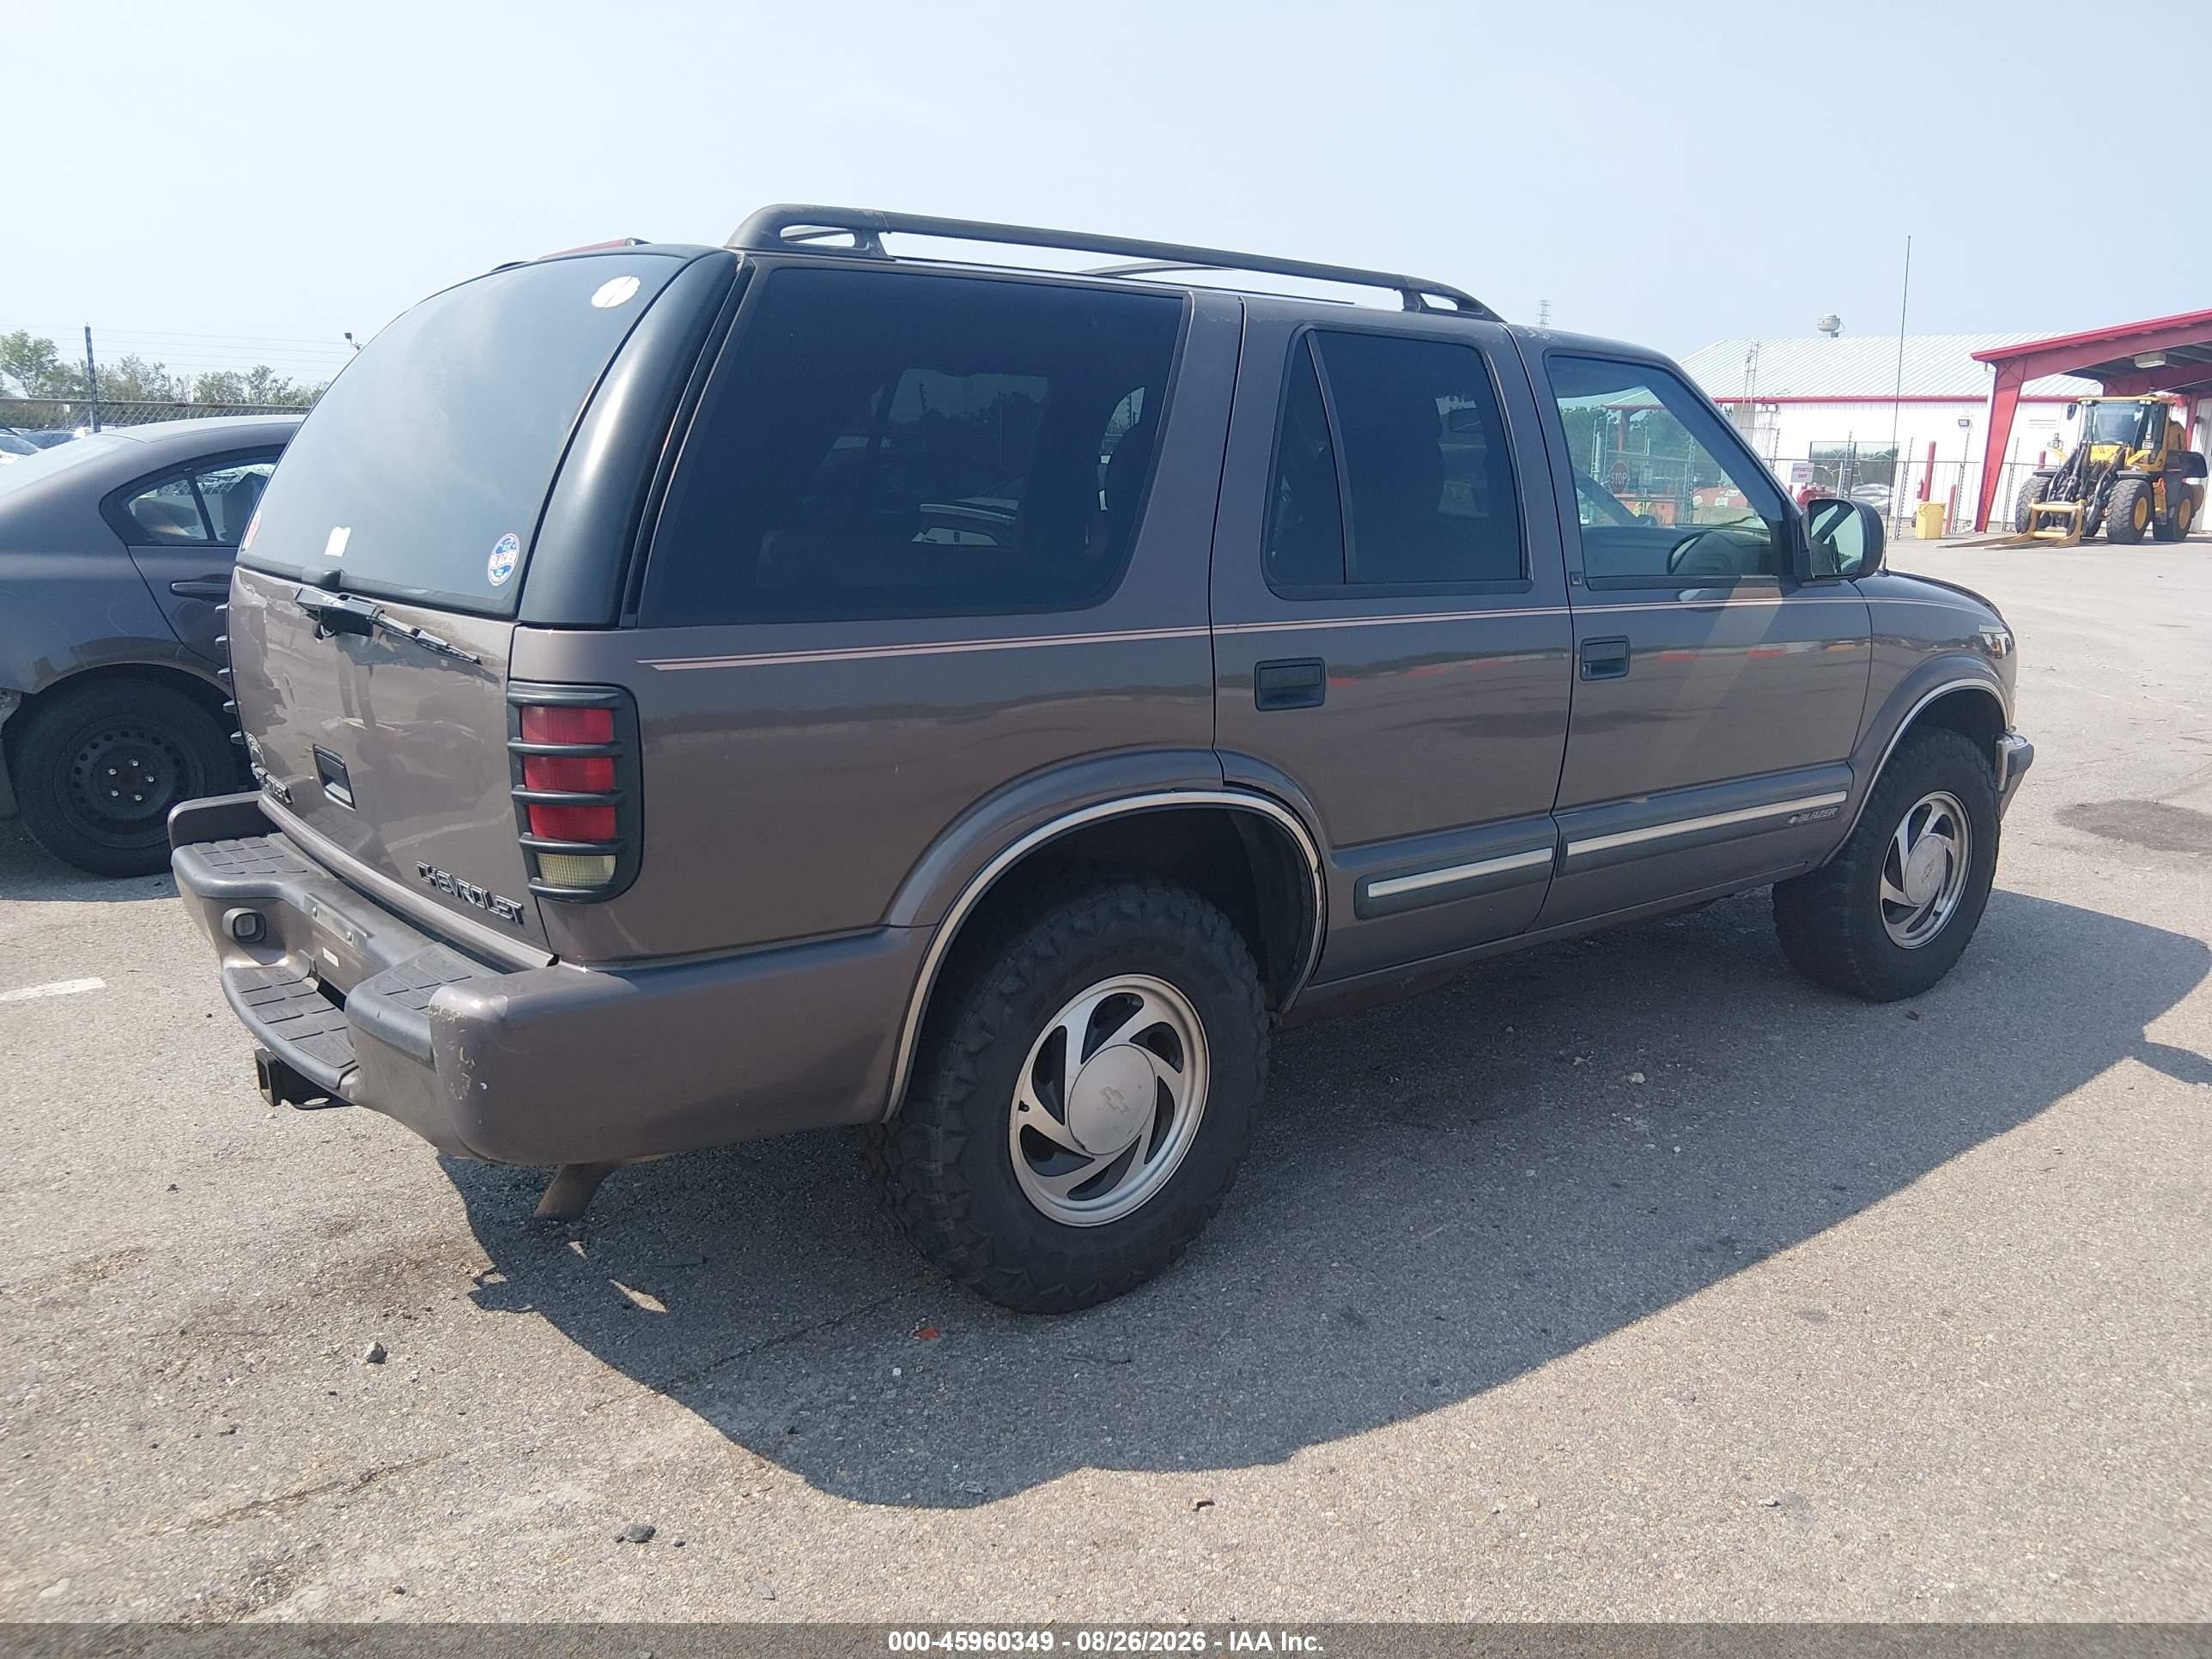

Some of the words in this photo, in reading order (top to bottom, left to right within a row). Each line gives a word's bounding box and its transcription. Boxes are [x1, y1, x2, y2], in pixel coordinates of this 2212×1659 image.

[1611, 472, 1627, 485] STOP
[1798, 807, 1838, 823] BLAZER
[416, 860, 524, 927] CHEVROLET
